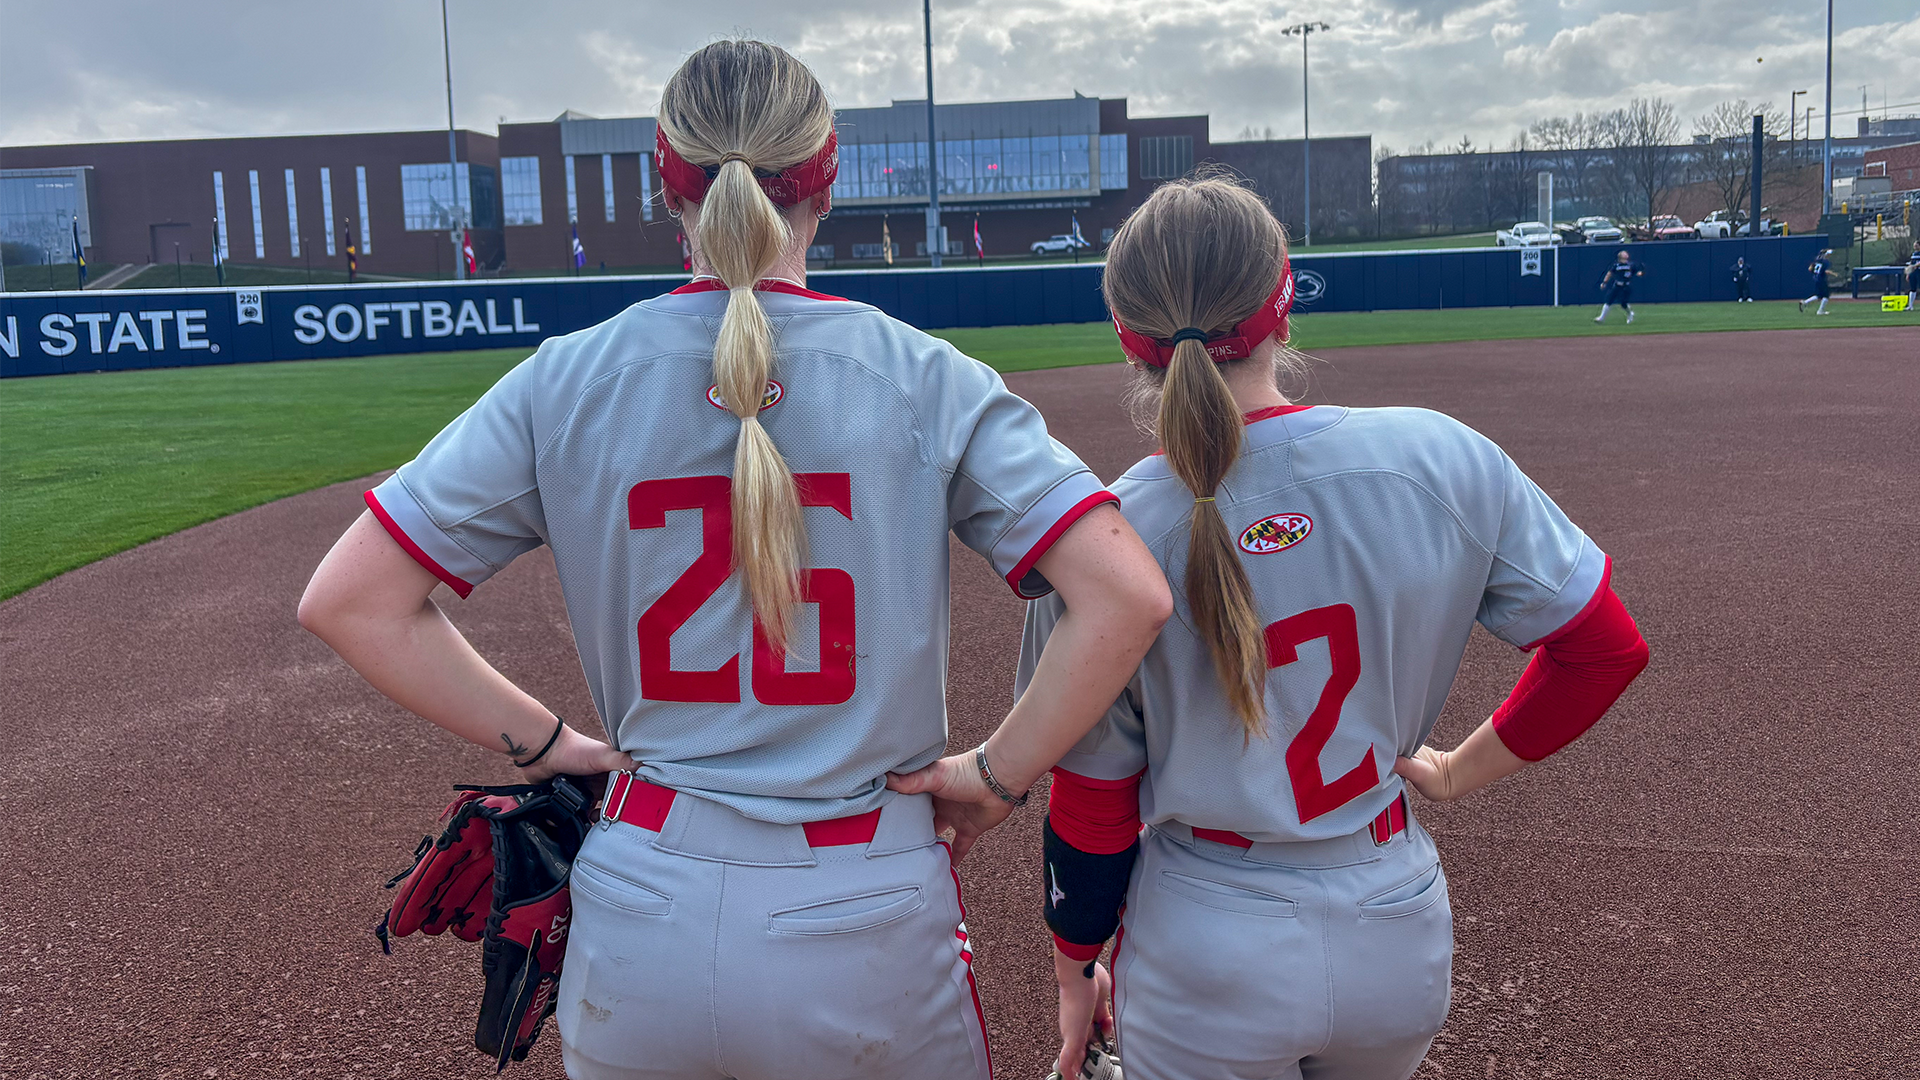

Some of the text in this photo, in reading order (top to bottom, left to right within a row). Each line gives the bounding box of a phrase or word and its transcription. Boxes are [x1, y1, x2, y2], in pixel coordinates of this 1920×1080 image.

[1523, 252, 1539, 260] 200
[240, 294, 259, 304] 220
[294, 297, 540, 344] SOFTBALL
[627, 472, 856, 706] 26
[1263, 603, 1380, 825] 2
